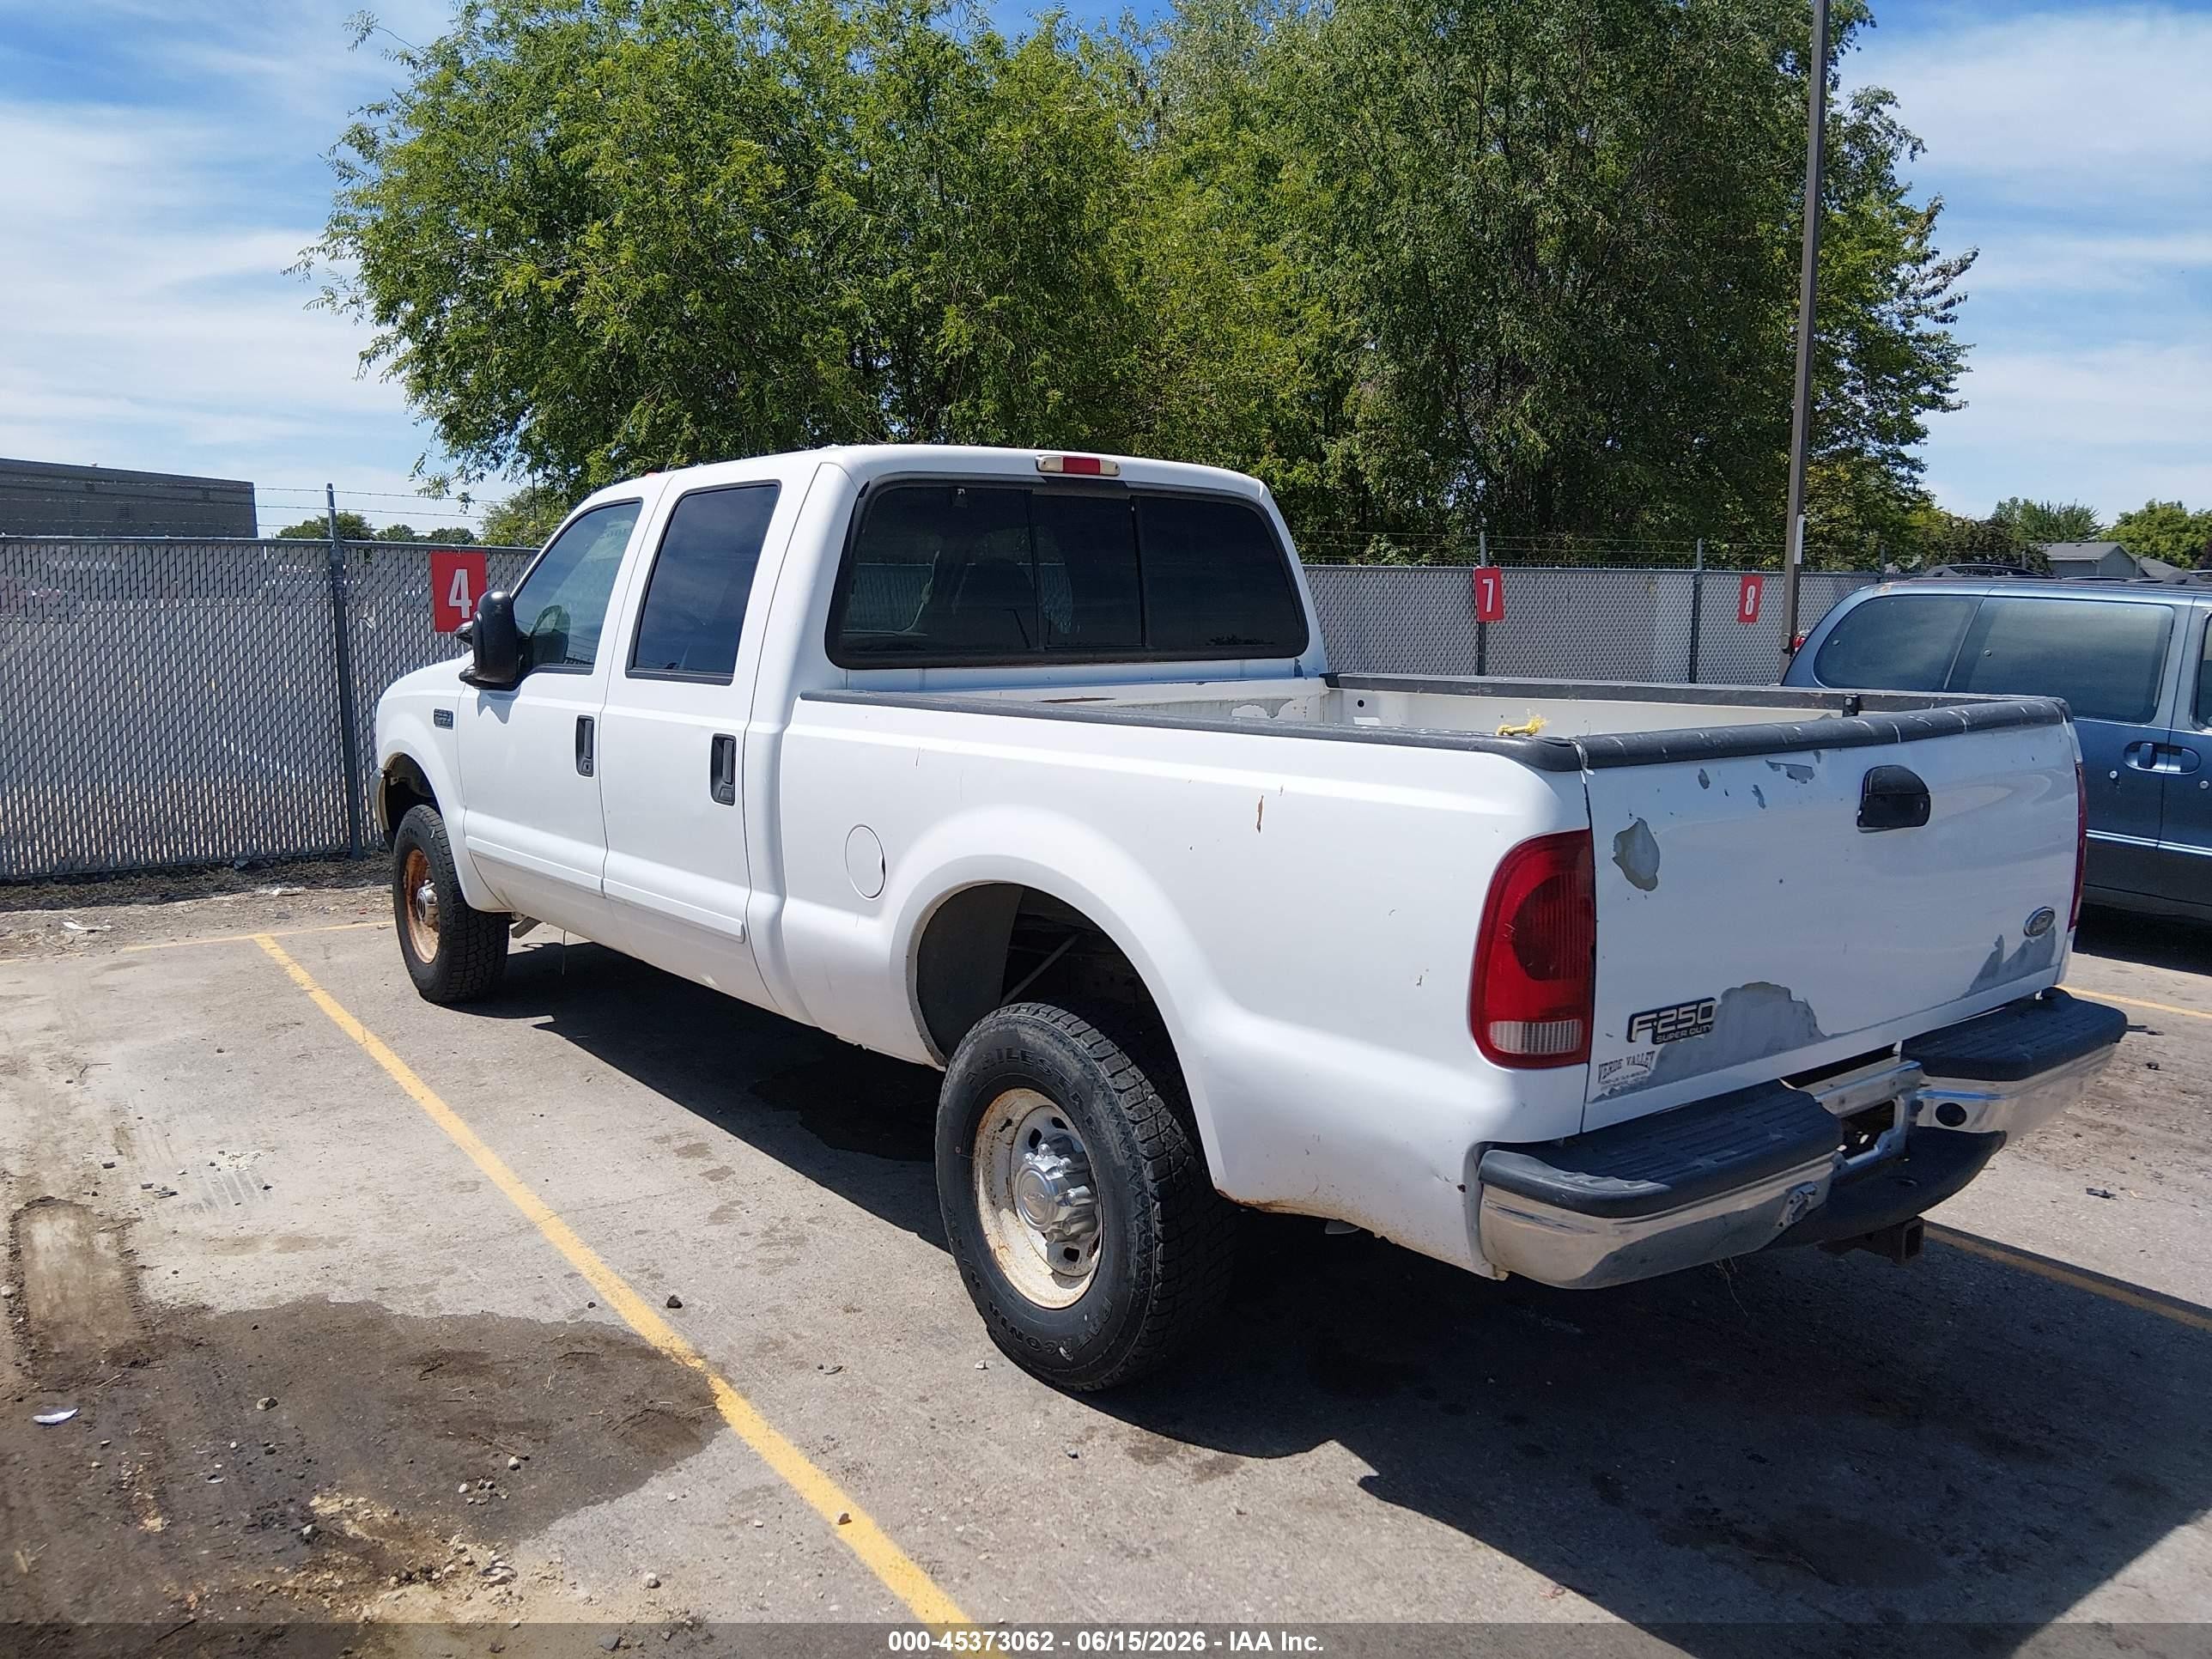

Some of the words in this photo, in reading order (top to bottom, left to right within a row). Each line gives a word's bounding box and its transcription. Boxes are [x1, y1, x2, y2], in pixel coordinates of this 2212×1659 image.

[448, 568, 473, 619] 4
[1482, 578, 1494, 612] 7
[1744, 585, 1756, 616] 8
[1656, 1030, 1688, 1043] SUPER
[1688, 1024, 1712, 1036] DUTY
[1626, 1050, 1656, 1073] VALLEY
